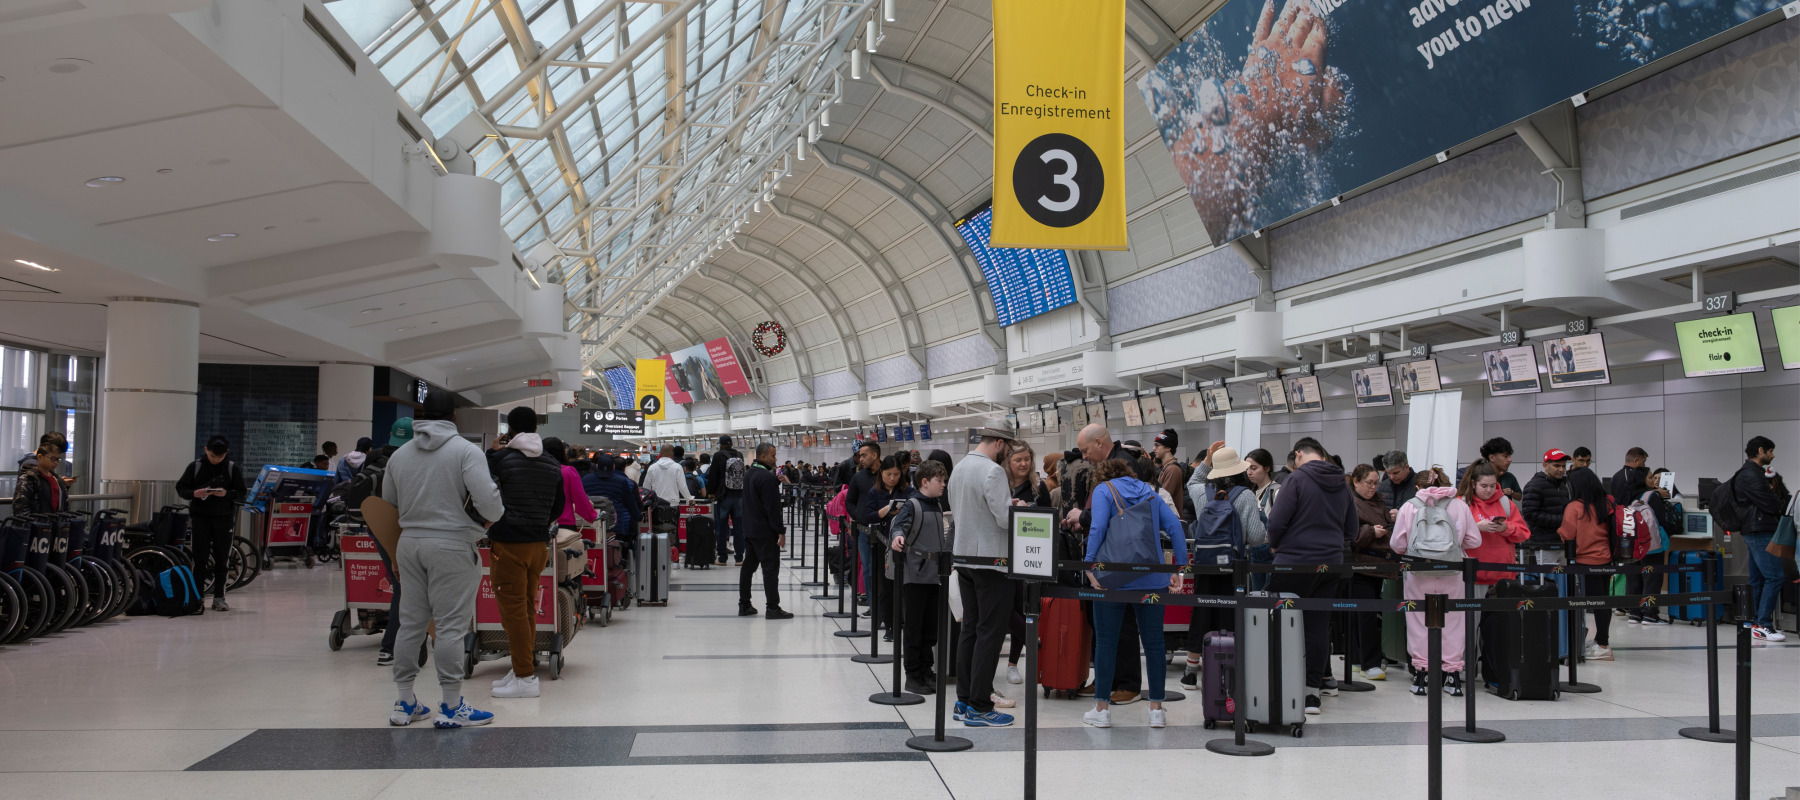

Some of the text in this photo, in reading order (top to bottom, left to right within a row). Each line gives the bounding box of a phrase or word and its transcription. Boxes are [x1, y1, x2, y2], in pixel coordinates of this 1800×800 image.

[1409, 0, 1459, 28] adv
[1417, 28, 1460, 70] you
[1455, 16, 1482, 42] to
[1026, 84, 1086, 100] Check-in
[1001, 102, 1111, 120] Enregistrement
[1037, 148, 1080, 212] 3
[1706, 296, 1728, 310] 337
[1568, 320, 1585, 332] 338
[1698, 326, 1733, 338] check-in
[1502, 331, 1517, 344] 339
[1412, 346, 1425, 356] 340
[1708, 352, 1722, 361] flair
[1367, 354, 1377, 363] 341
[1300, 364, 1309, 374] 342
[644, 398, 656, 412] 4
[1026, 546, 1041, 554] EXIT
[1024, 560, 1042, 568] ONLY
